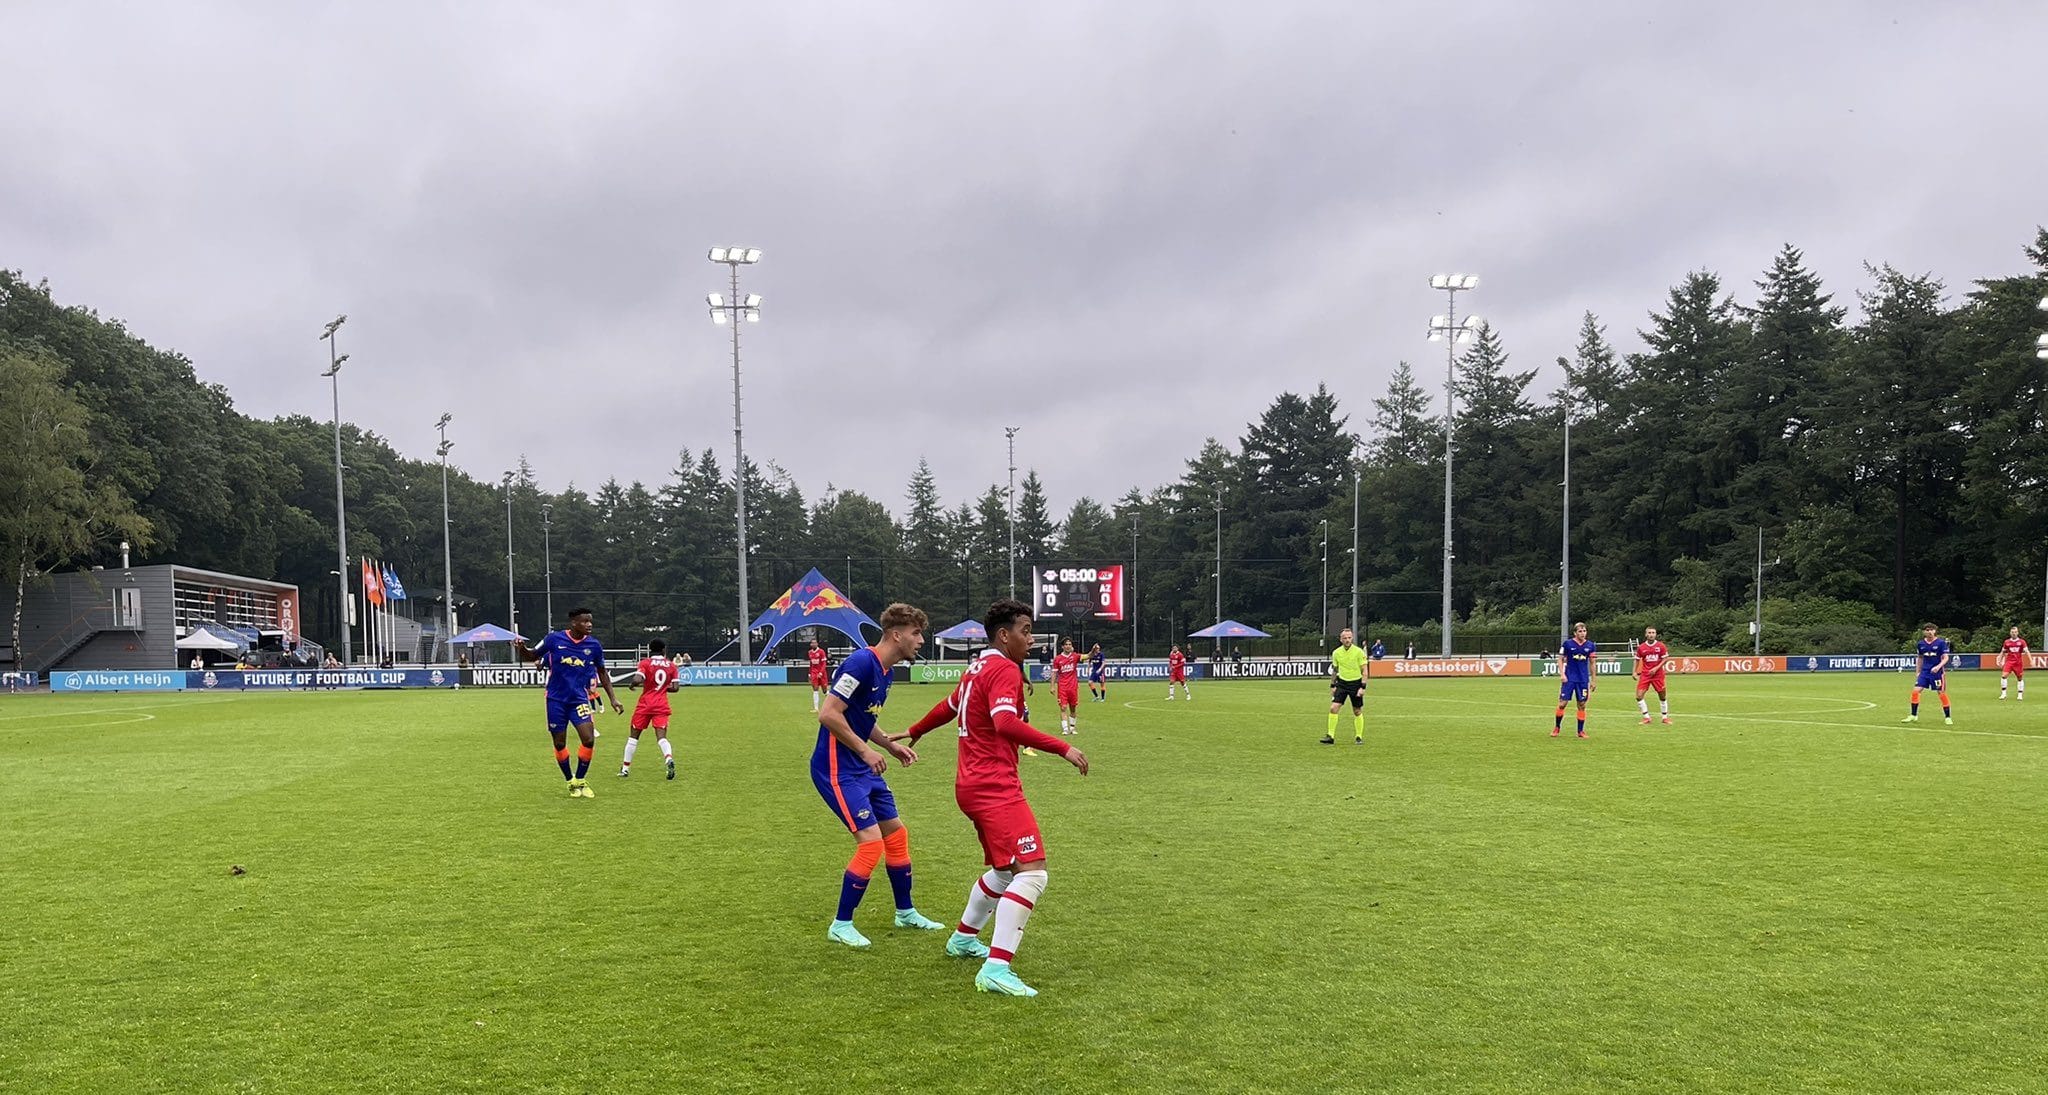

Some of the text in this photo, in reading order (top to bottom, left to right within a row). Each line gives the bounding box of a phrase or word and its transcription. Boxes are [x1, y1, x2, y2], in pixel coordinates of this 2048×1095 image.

[1060, 569, 1096, 582] 05:00
[1042, 584, 1060, 593] RBL
[1100, 584, 1111, 592] AZ
[1046, 593, 1056, 606] 0
[1101, 593, 1110, 605] 0
[1394, 661, 1485, 674] Staatsloterij
[1596, 662, 1621, 673] TOTO
[1724, 659, 1752, 672] ING
[1829, 657, 1917, 669] FUTURE OF FOOTBAL
[695, 669, 769, 681] Albert Heijn
[937, 668, 960, 679] kpn
[1104, 667, 1169, 677] OF FOOTBALL
[1212, 662, 1324, 677] NIKE.COM/FOOTBALL
[85, 673, 171, 686] Albert Heijn
[244, 672, 405, 685] FUTURE OF FOOTBALL CUP
[655, 669, 667, 691] 9
[1017, 835, 1035, 845] AFAS
